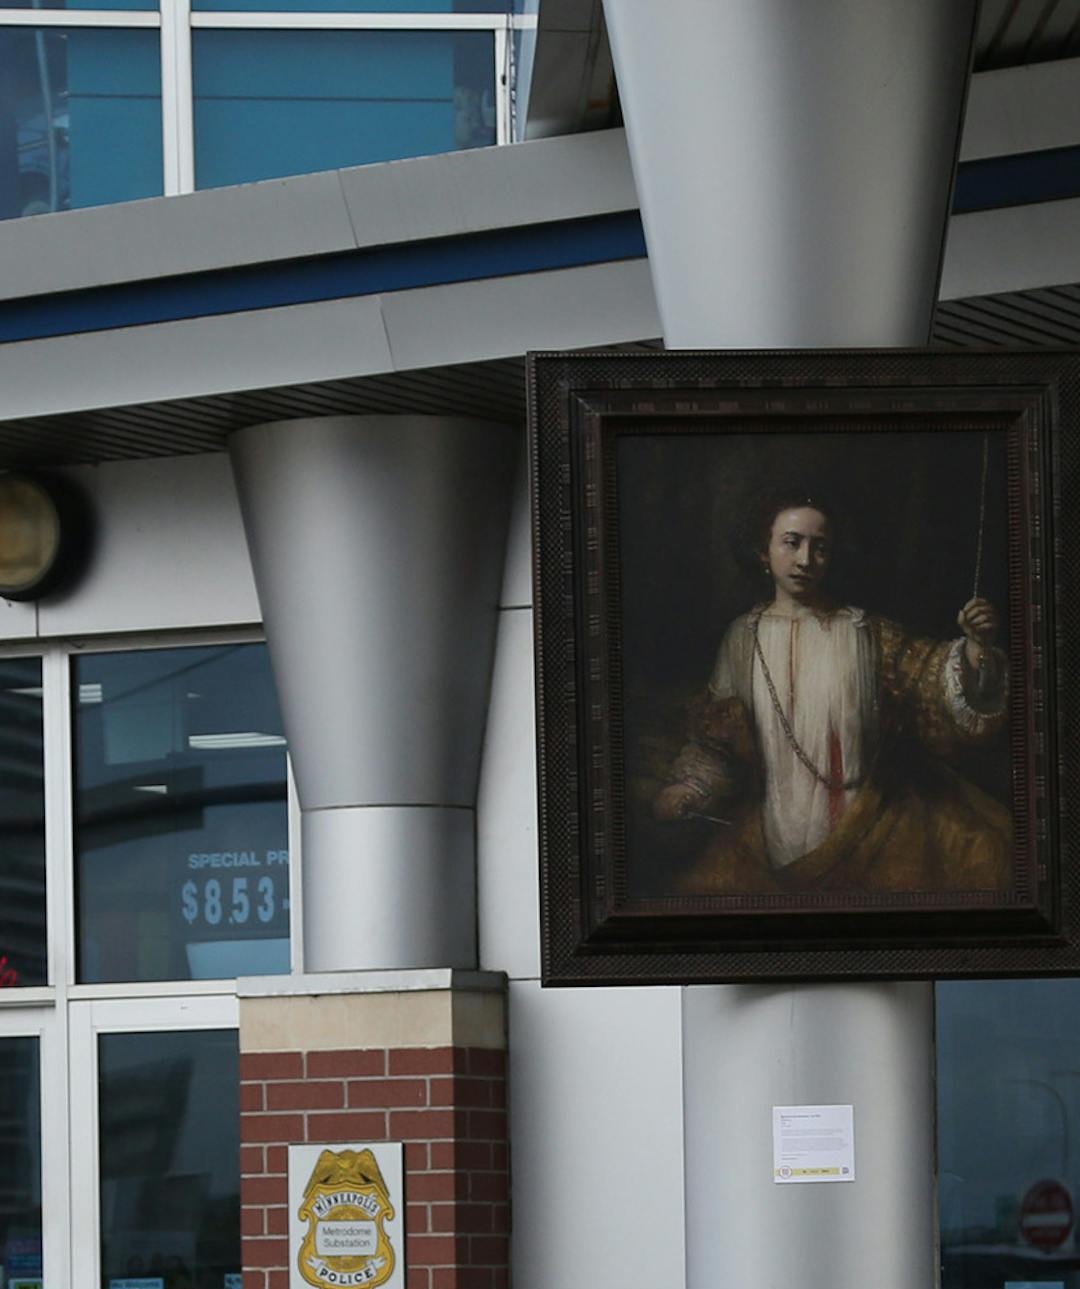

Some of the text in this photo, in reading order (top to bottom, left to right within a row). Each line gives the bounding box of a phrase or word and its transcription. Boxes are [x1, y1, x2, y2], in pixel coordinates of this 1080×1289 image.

[188, 851, 261, 869] SPECIAL
[314, 1193, 379, 1213] MINNEAPOLIS
[322, 1226, 372, 1236] Metrodome
[323, 1238, 371, 1248] Substation
[319, 1268, 373, 1284] POLICE
